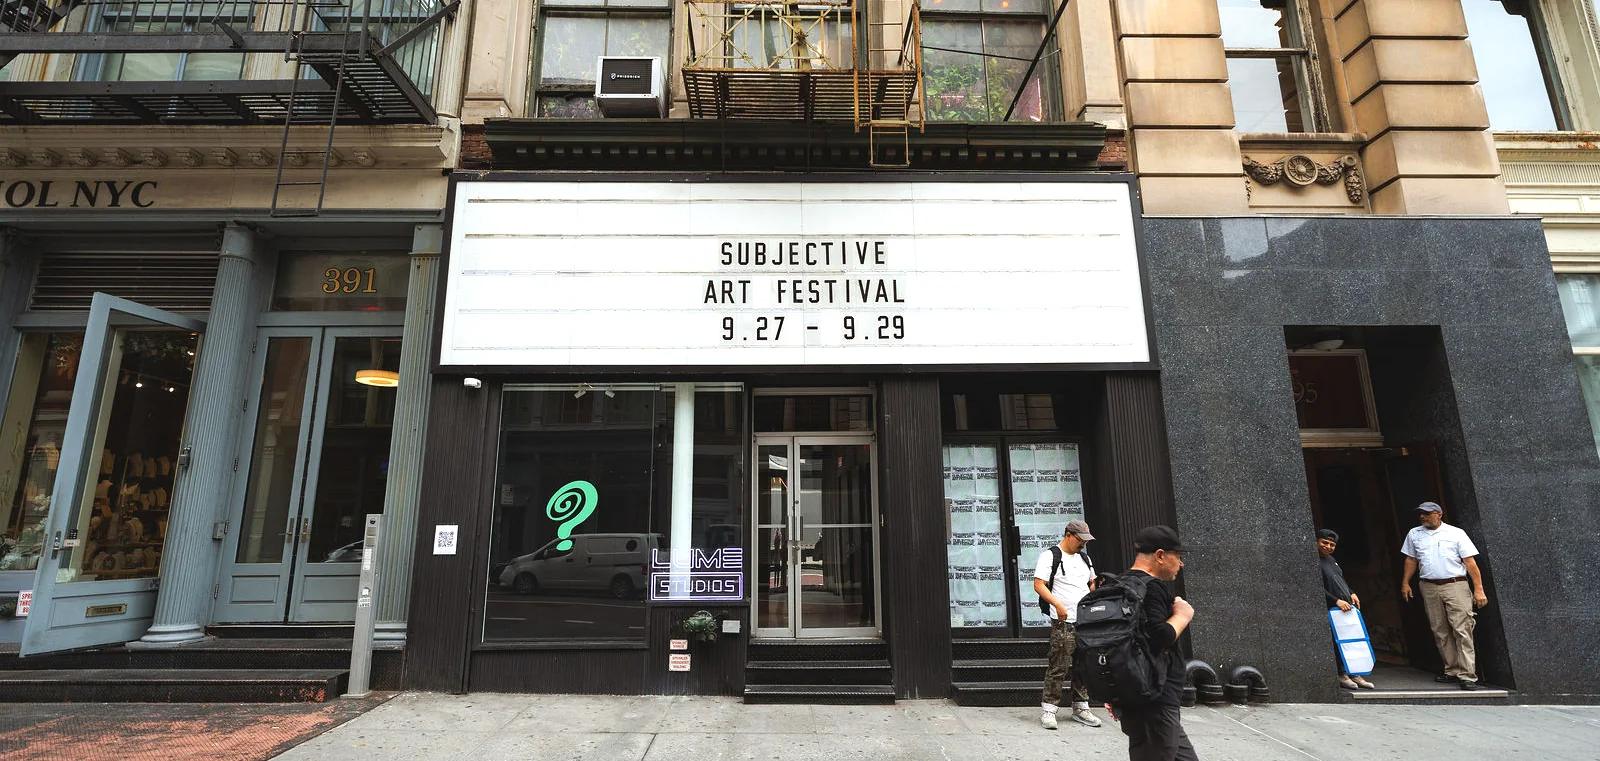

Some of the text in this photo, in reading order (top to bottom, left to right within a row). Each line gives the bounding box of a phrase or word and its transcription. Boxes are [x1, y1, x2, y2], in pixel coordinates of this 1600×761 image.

[0, 180, 158, 207] OL NYC
[720, 241, 886, 266] SUBJECTIVE
[321, 267, 377, 294] 391
[703, 279, 905, 304] ART FESTIVAL
[722, 316, 785, 341] 9.27
[843, 315, 905, 340] 9.29
[652, 548, 743, 569] LUME
[660, 580, 735, 593] STUDIOS
